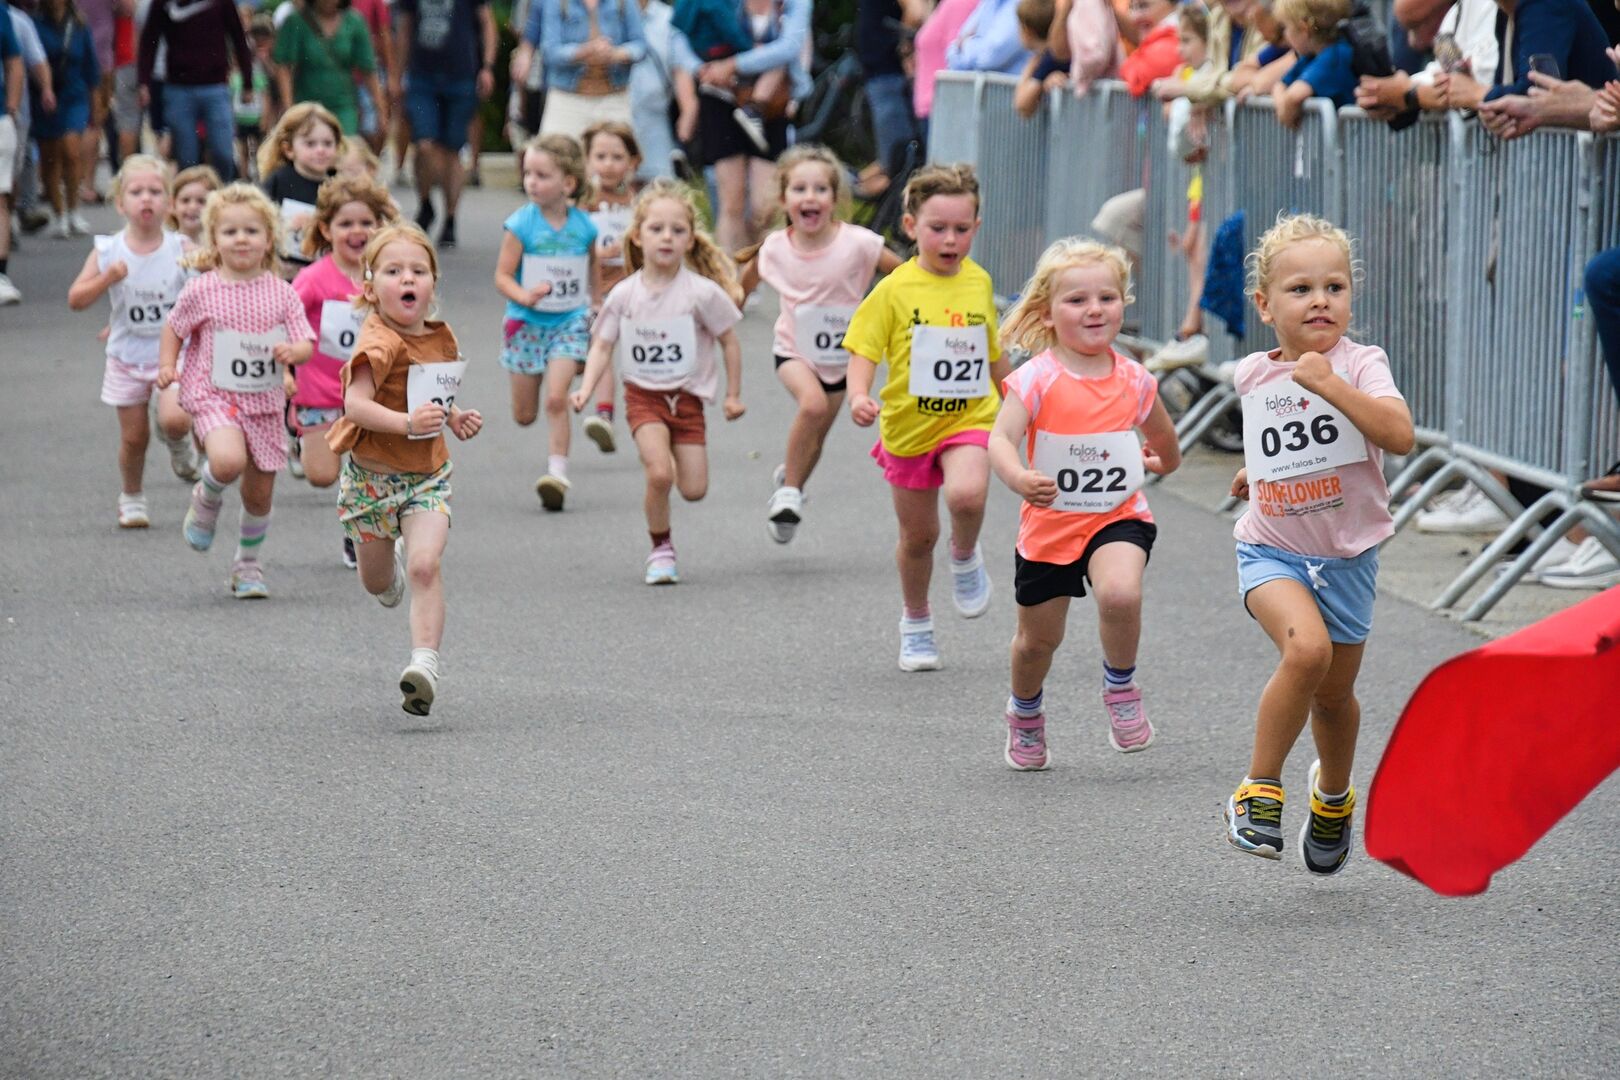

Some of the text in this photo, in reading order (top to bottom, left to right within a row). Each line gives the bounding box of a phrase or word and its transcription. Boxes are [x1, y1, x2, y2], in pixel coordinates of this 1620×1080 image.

[815, 332, 847, 350] 02
[632, 344, 682, 363] 023
[231, 358, 276, 378] 031
[933, 358, 984, 381] 027
[1265, 394, 1293, 411] falos
[1261, 414, 1339, 458] 036
[1069, 444, 1097, 457] falos
[1271, 456, 1328, 474] www.falos.be
[1057, 467, 1127, 493] 022
